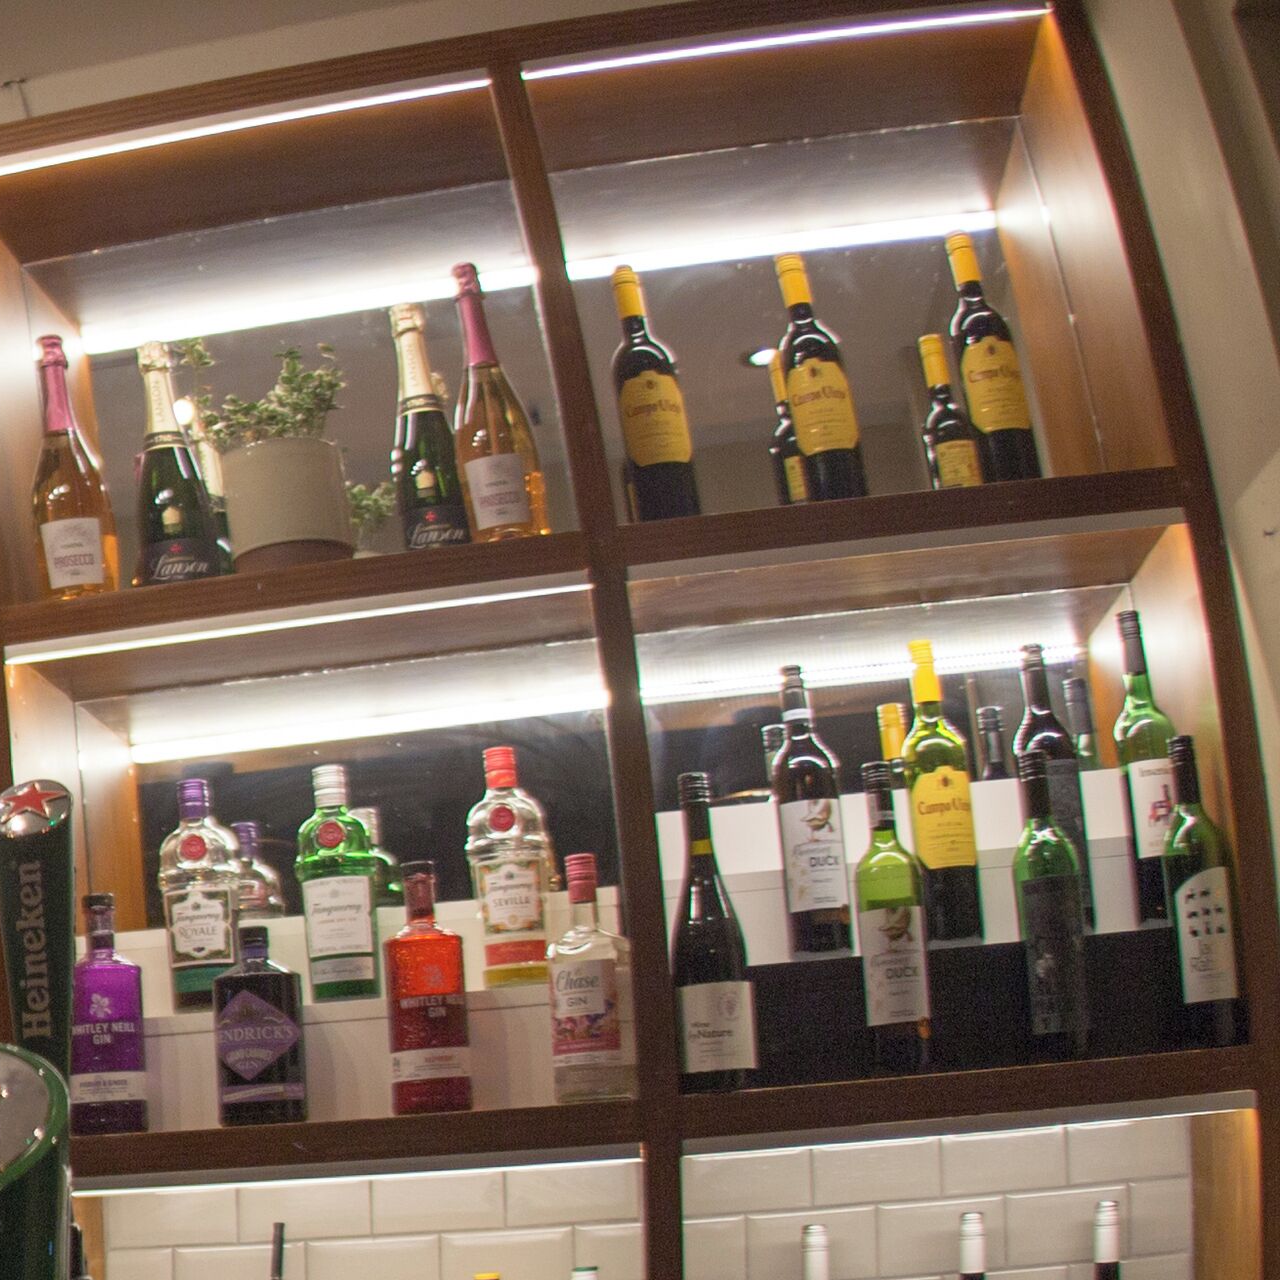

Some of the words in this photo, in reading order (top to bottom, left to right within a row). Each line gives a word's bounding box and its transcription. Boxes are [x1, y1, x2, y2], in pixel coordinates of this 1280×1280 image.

[15, 860, 53, 1039] Heineken
[556, 968, 600, 992] Chase
[92, 1034, 112, 1045] GIN
